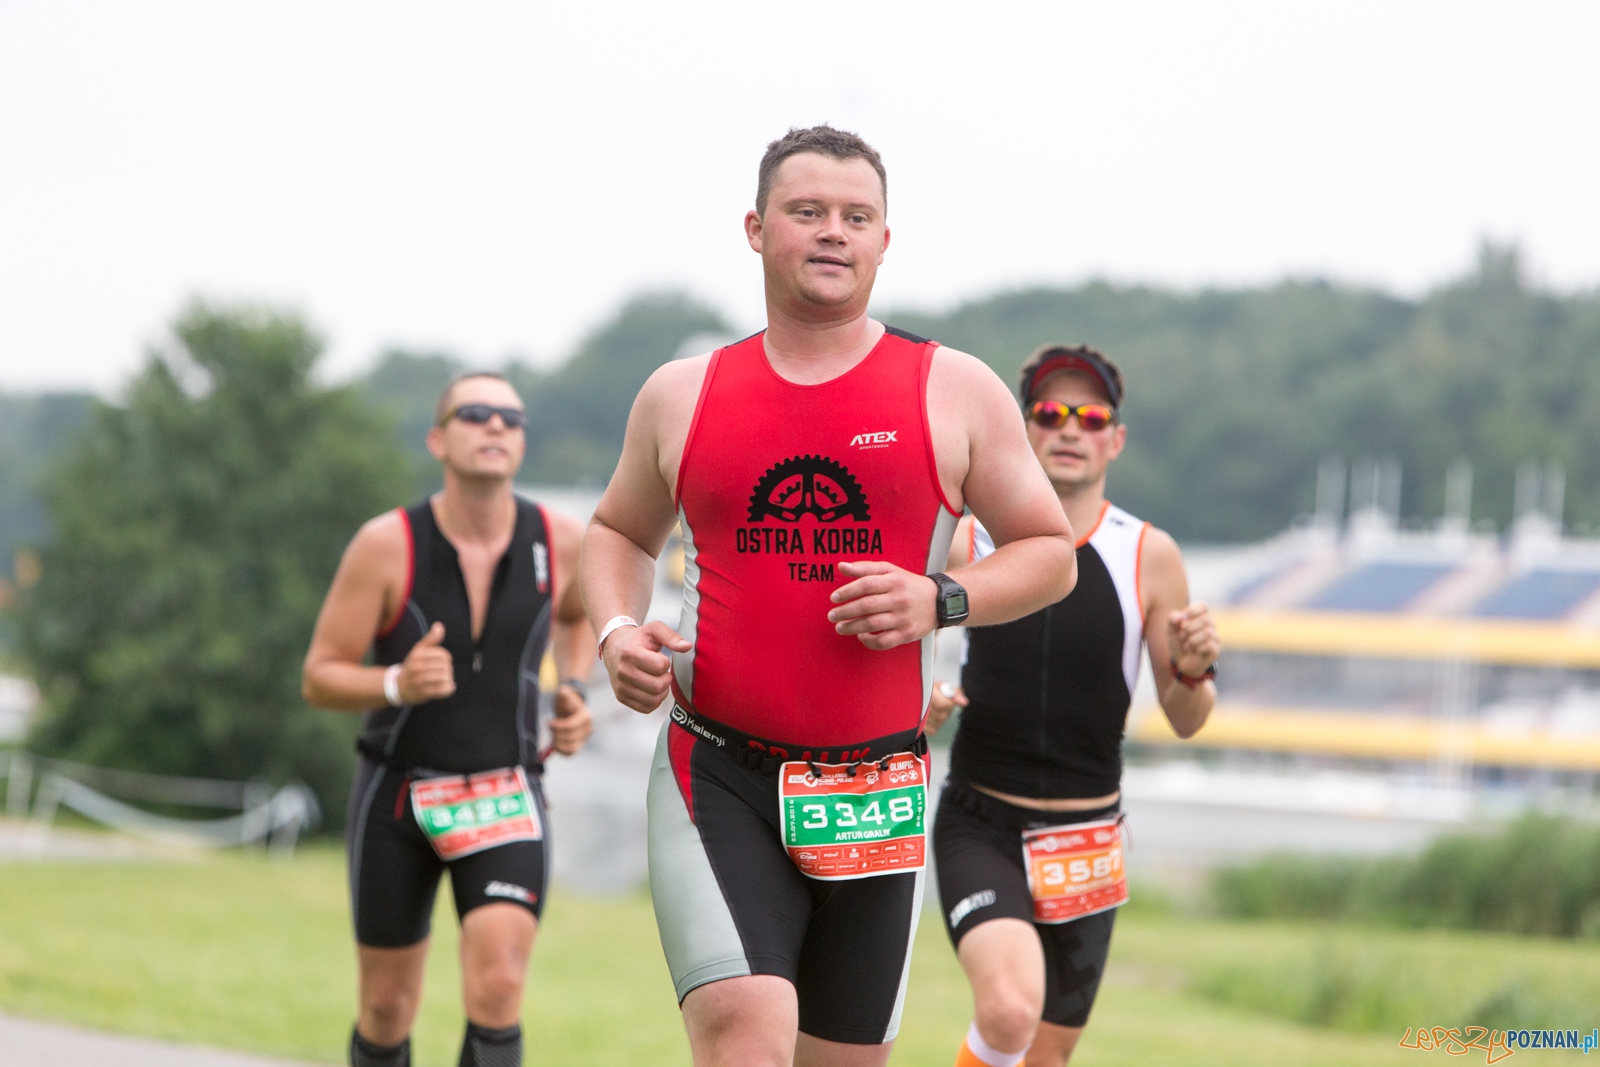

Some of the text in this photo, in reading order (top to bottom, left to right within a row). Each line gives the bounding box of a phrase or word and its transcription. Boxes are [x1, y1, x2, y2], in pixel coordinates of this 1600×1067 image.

[849, 430, 898, 447] ATEX
[736, 527, 883, 555] OSTRA KORBA
[787, 562, 834, 582] TEAM
[686, 717, 726, 747] Kalenji
[889, 760, 914, 772] OLIMPIC
[802, 796, 914, 829] 3348
[835, 828, 891, 841] ARTUR GRALIK
